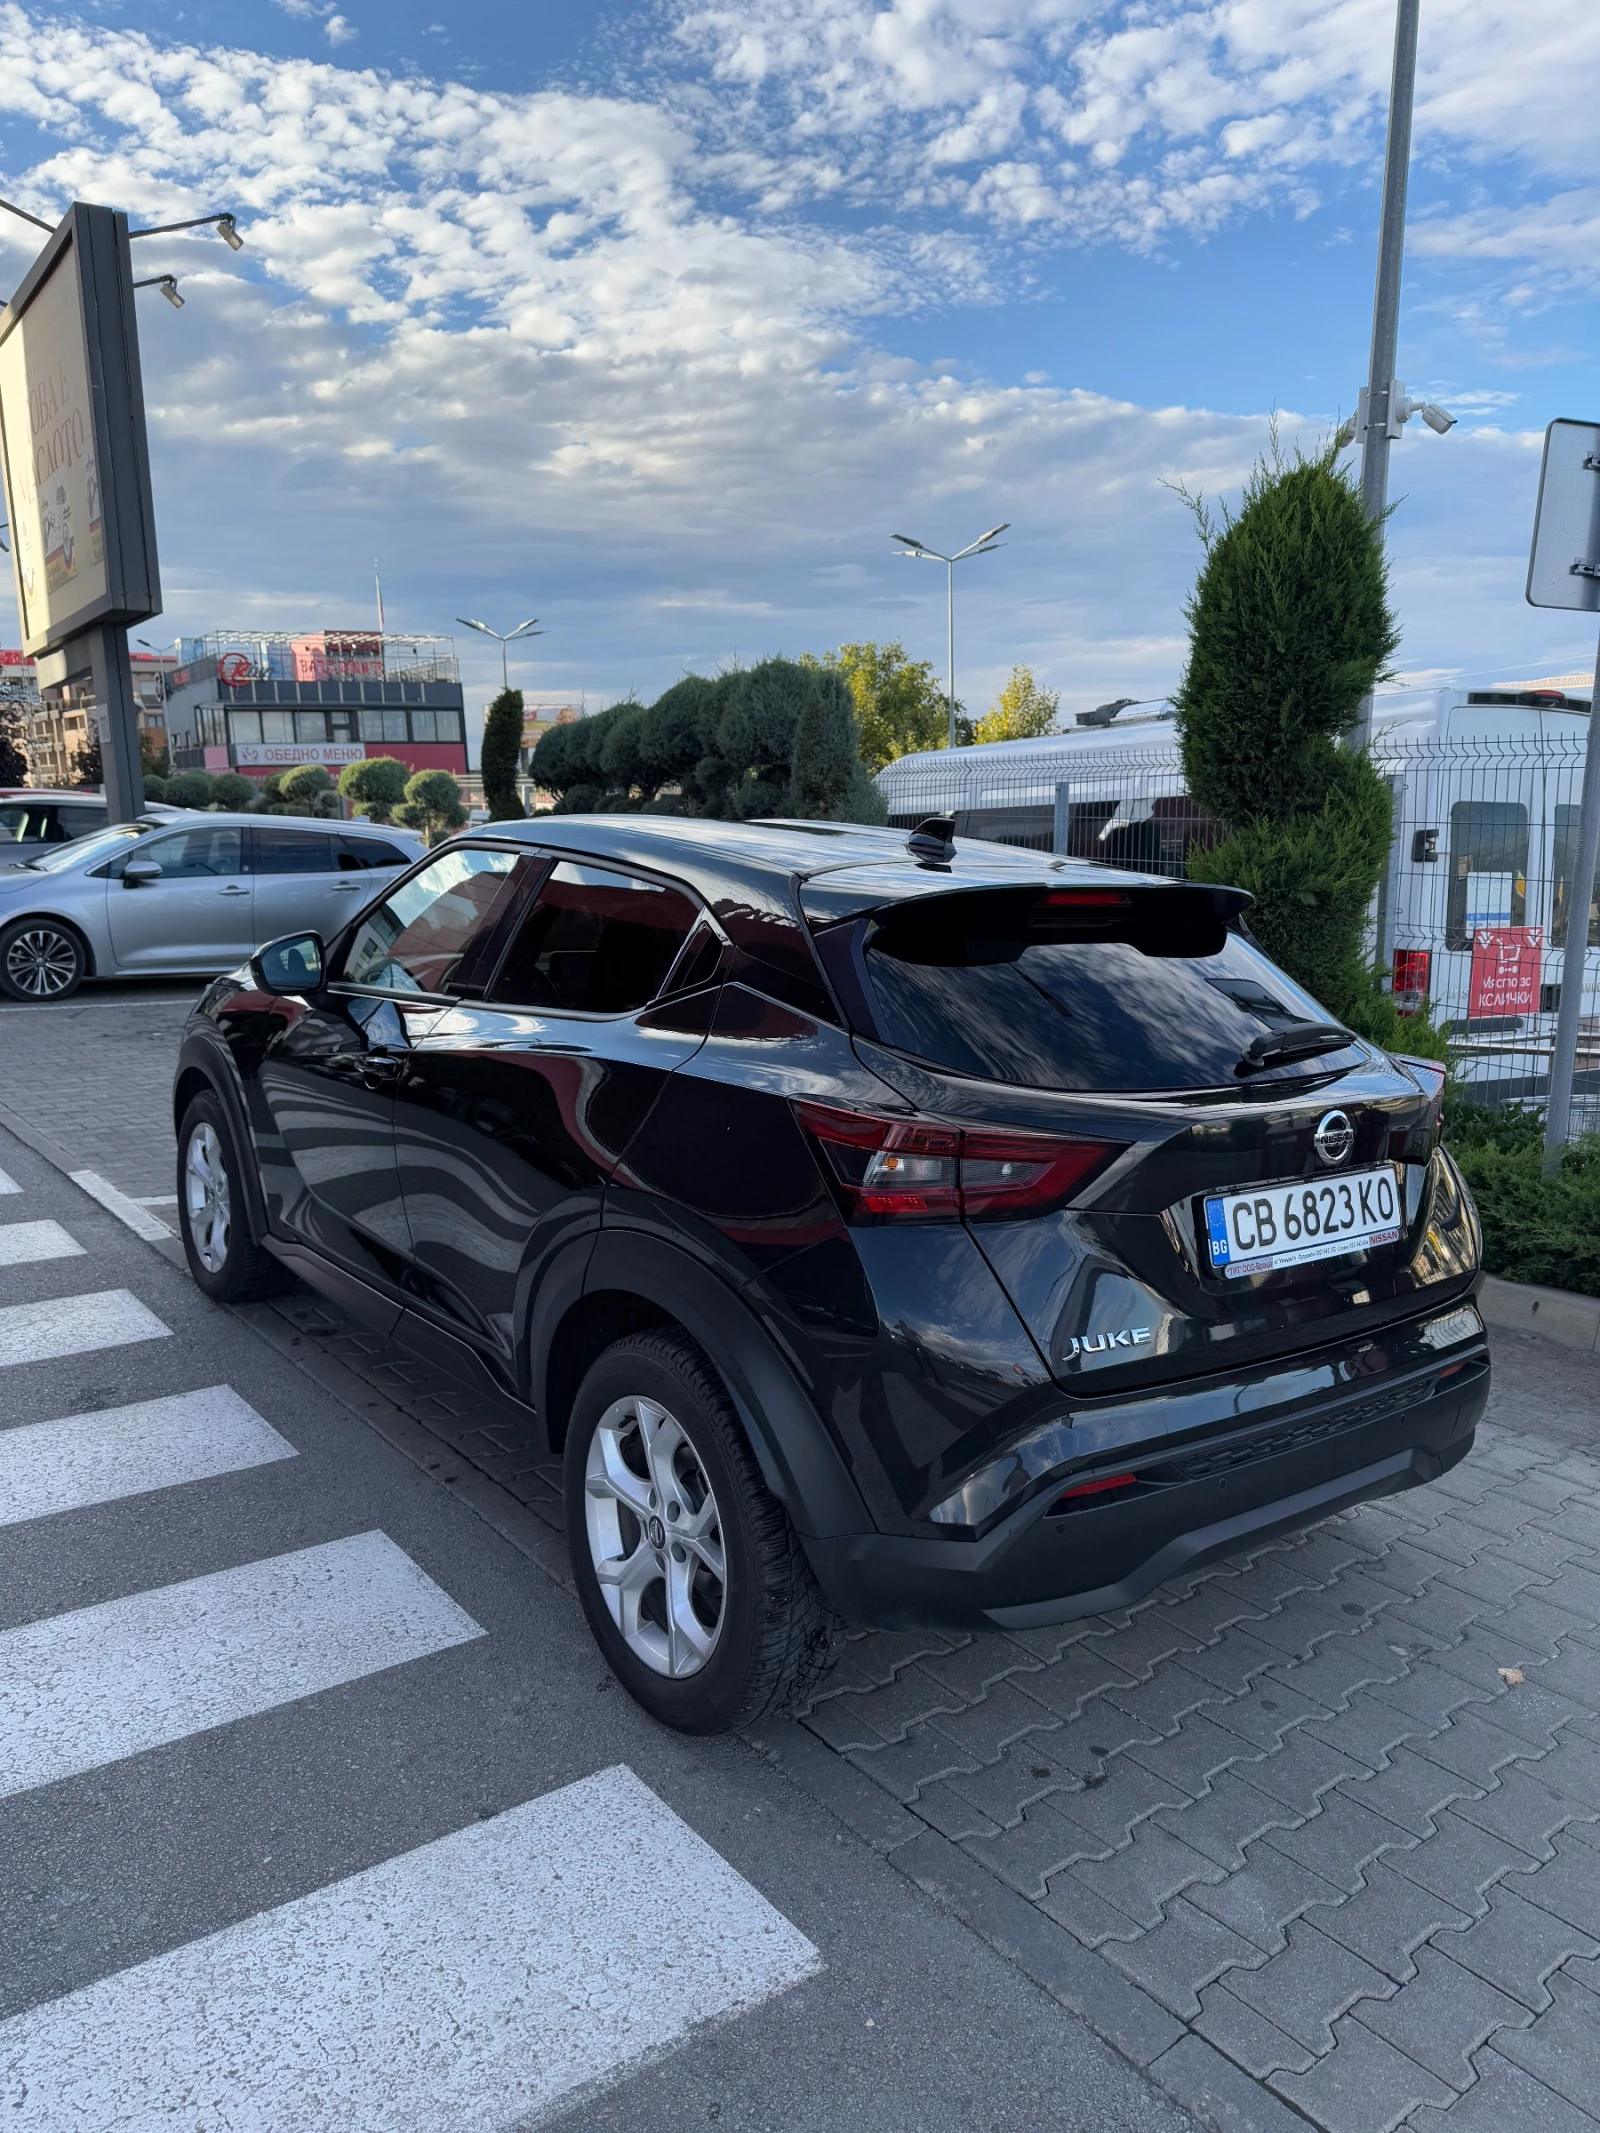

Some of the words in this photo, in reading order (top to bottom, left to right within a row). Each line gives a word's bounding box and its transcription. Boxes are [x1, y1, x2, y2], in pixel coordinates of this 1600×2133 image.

[265, 748, 319, 762] ОБЕДНО
[323, 748, 362, 761] МЕНЮ
[1479, 991, 1533, 1007] КОЛИЧКИ
[1284, 1184, 1355, 1240] 6823
[1370, 1230, 1398, 1244] NISSAN
[1211, 1239, 1228, 1256] BG
[1062, 1327, 1152, 1361] JUKE
